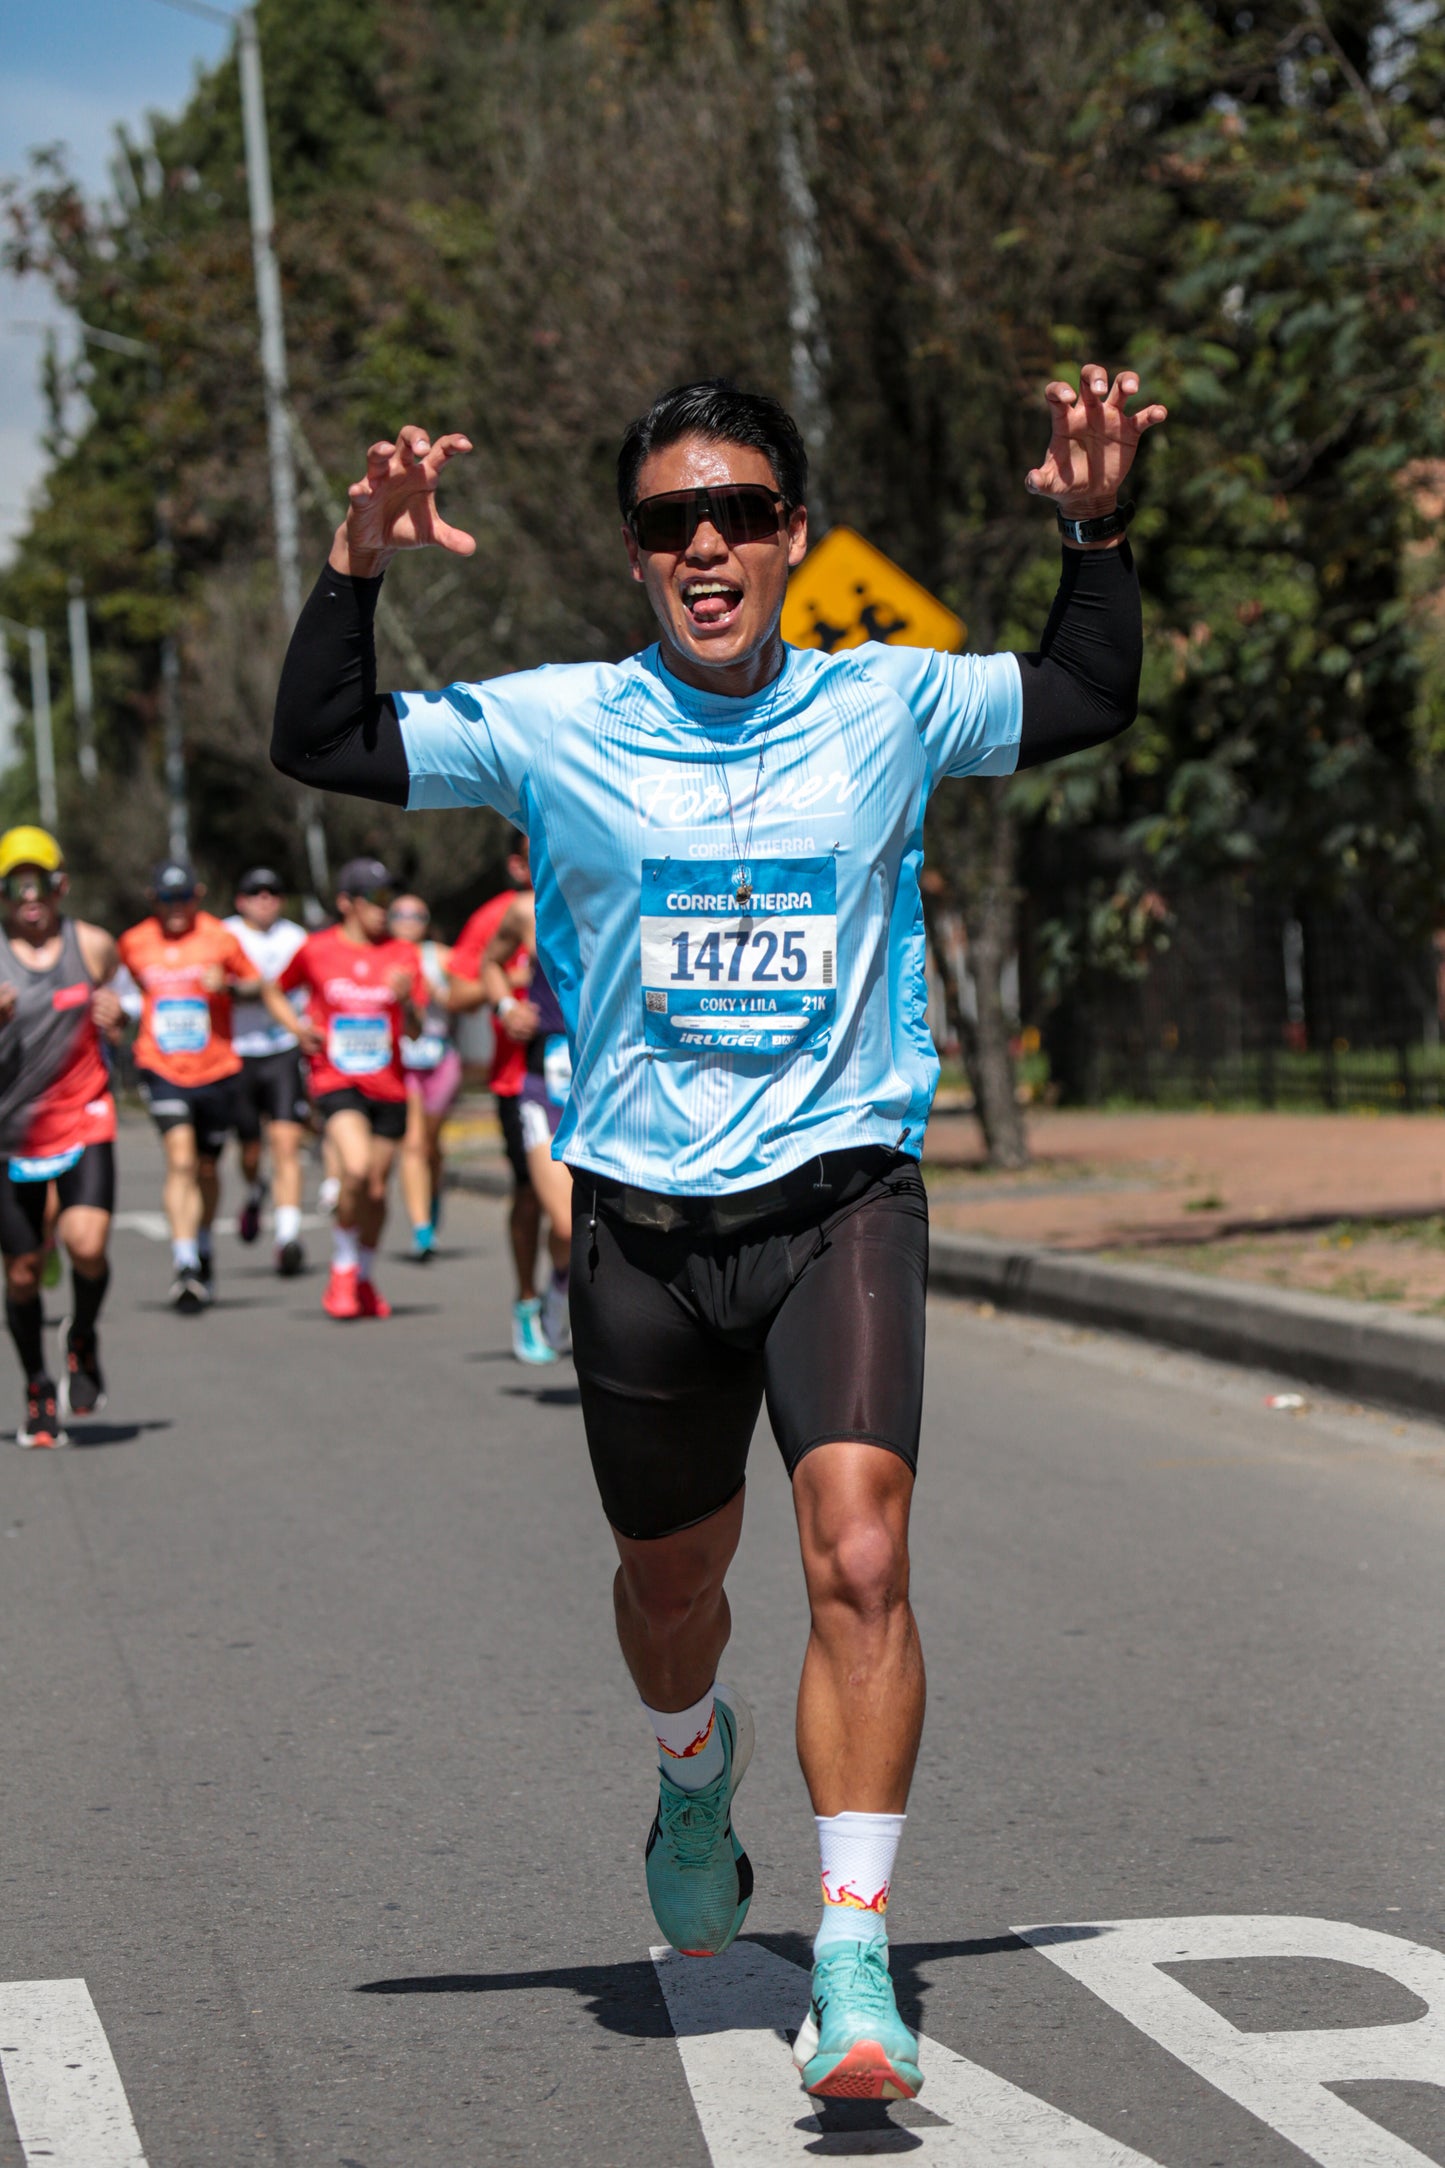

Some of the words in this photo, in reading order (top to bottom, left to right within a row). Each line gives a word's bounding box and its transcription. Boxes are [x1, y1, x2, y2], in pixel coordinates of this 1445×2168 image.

[671, 931, 807, 982] 14725
[699, 998, 735, 1012] COKY
[739, 998, 749, 1012] Y
[750, 998, 778, 1012] LILA
[801, 995, 827, 1012] 21K
